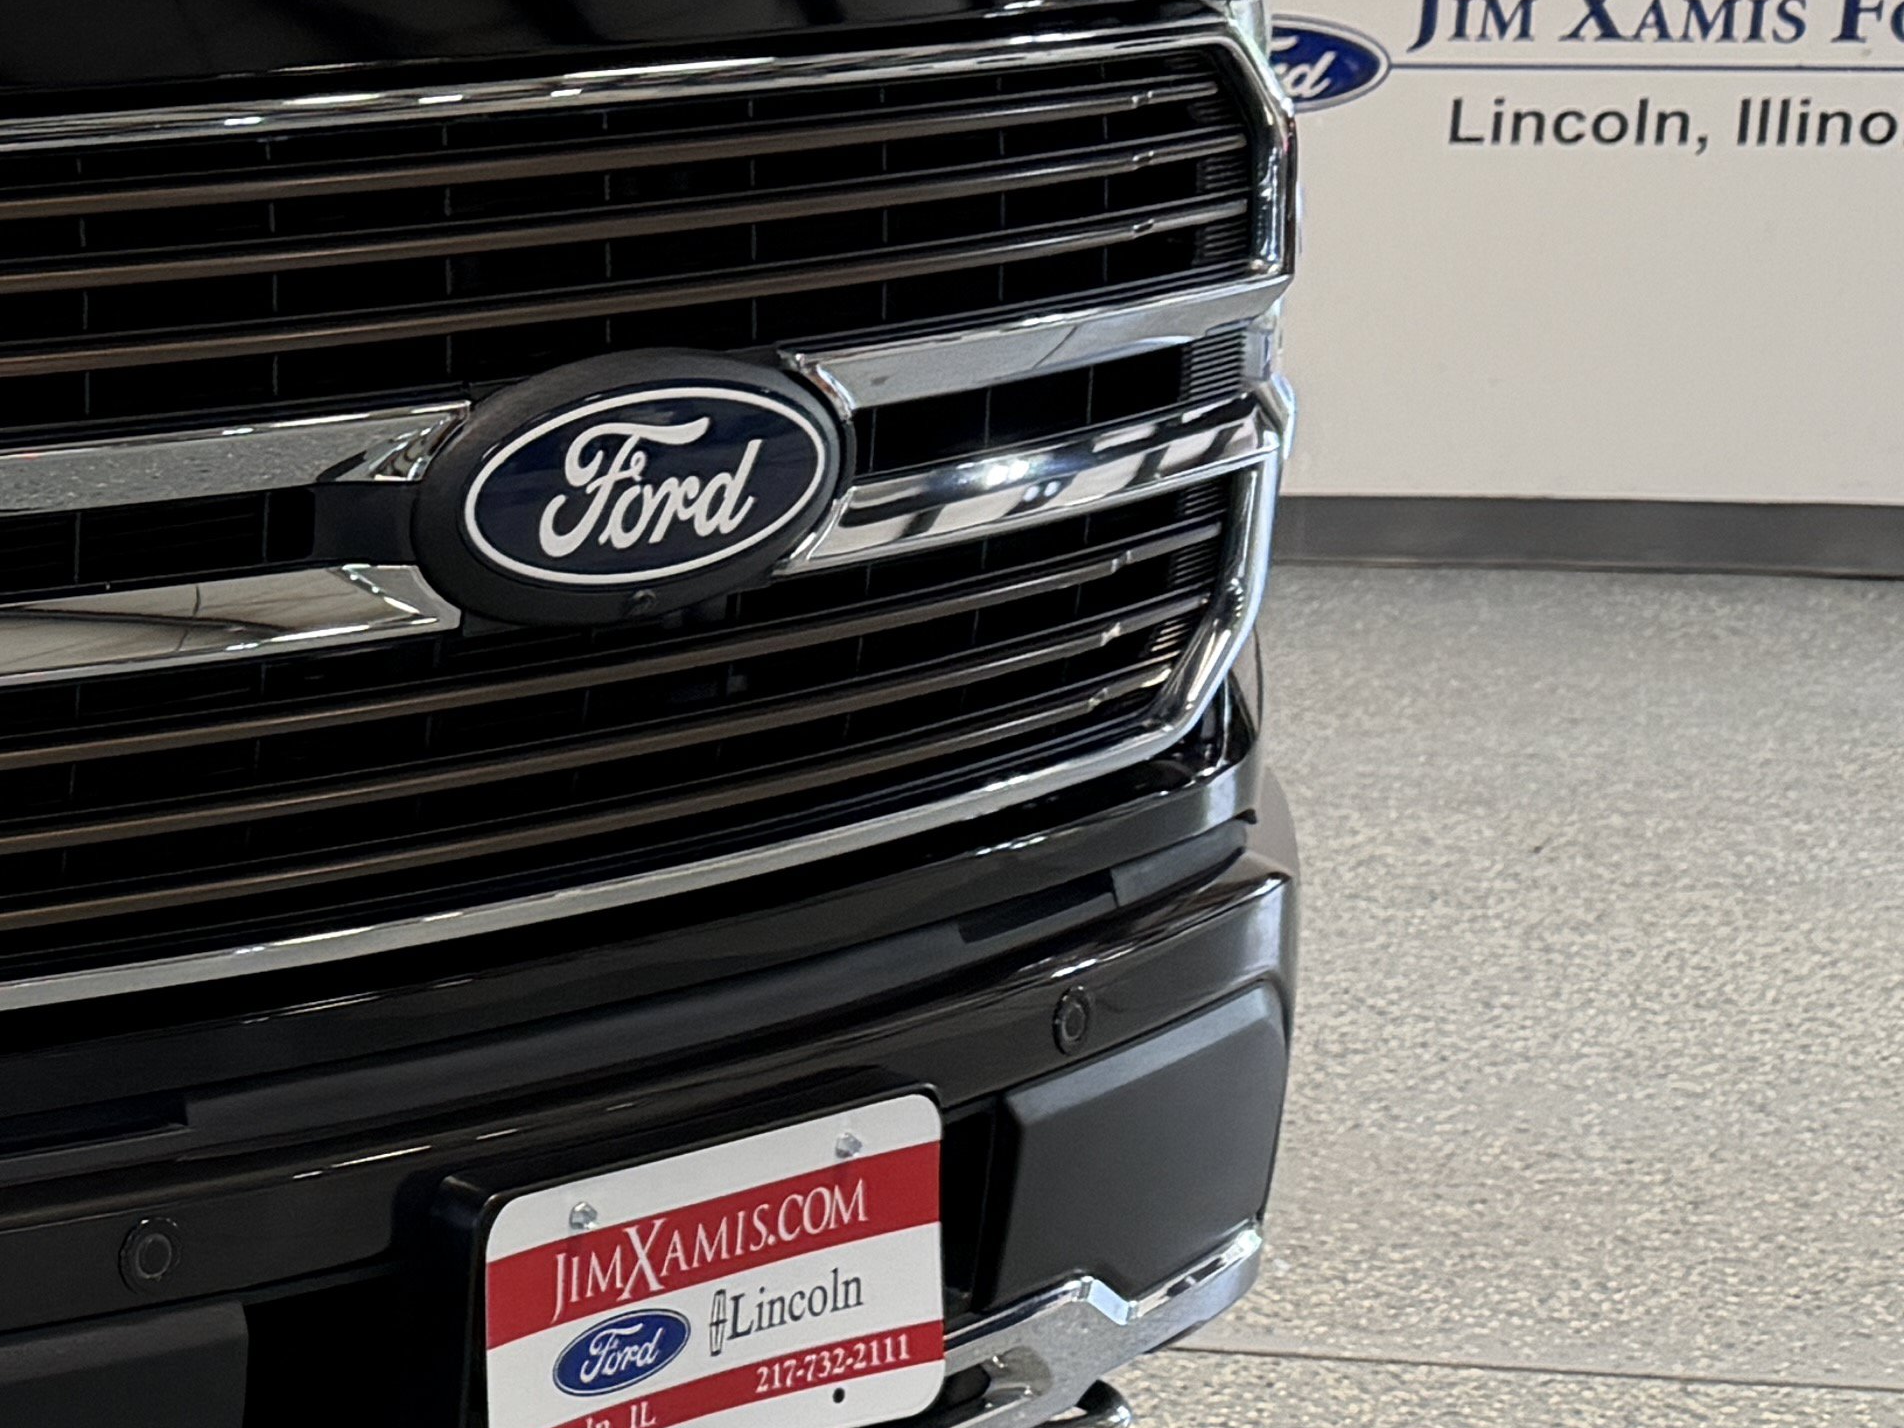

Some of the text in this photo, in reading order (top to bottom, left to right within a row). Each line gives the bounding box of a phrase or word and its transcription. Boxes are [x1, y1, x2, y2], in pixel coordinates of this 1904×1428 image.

[1448, 96, 1904, 157] Lincoln, Illino
[538, 415, 763, 559] Ford
[550, 1177, 870, 1324] JIMXAMIS.COM
[726, 1266, 865, 1341] Lincoln
[580, 1321, 667, 1384] Ford
[754, 1332, 912, 1394] 217-732-2111
